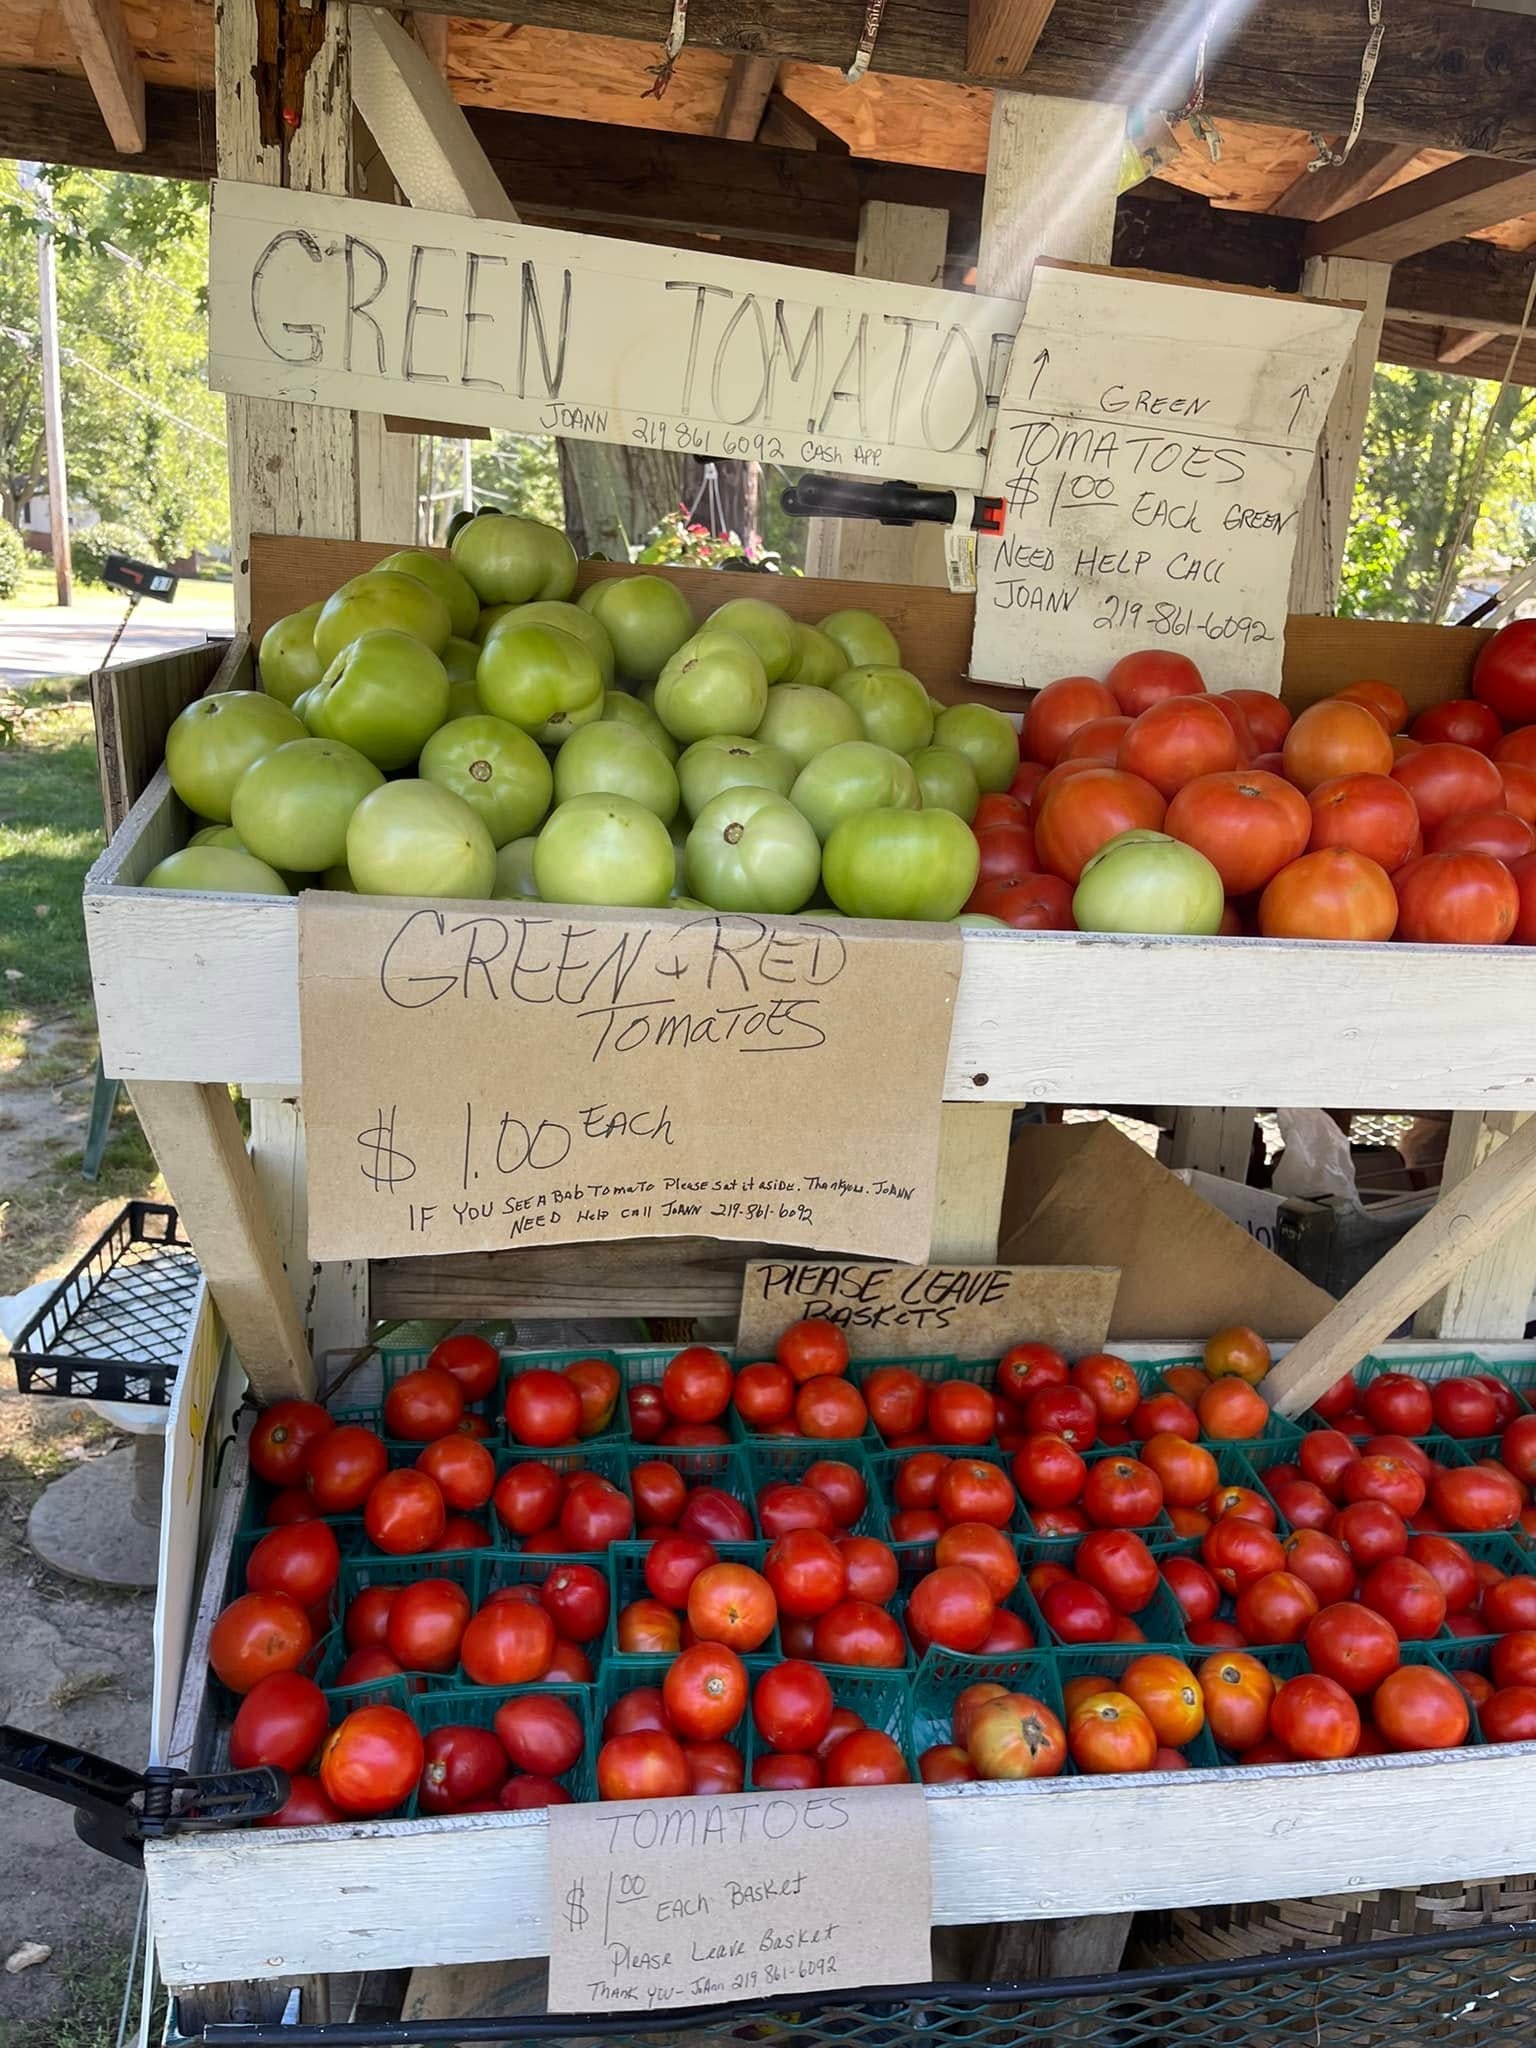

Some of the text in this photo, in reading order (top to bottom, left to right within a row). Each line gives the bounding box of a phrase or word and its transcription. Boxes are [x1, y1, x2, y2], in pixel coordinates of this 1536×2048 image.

[251, 229, 571, 400] GREEN
[1100, 385, 1211, 416] GREEN
[539, 403, 608, 433] JOANN
[632, 417, 666, 444] 219
[675, 423, 710, 449] 861
[723, 432, 784, 460] 6092
[1223, 504, 1299, 536] GREEN
[994, 535, 1054, 572] NEED
[1074, 546, 1151, 576] HELP
[994, 578, 1275, 644] JOANN 219-861-6092
[380, 909, 651, 1008] GREEN
[670, 915, 847, 992] RED
[409, 1204, 439, 1231] IF
[453, 1201, 494, 1225] YOU
[502, 1196, 534, 1215] SEE
[537, 1194, 547, 1206] A
[742, 1176, 756, 1191] it
[509, 1211, 562, 1239] NEED
[900, 1268, 1013, 1306] LEAVE
[596, 1797, 849, 1853] TOMATOES
[731, 1970, 758, 1990] 219
[764, 1955, 838, 1984] 861-6092
